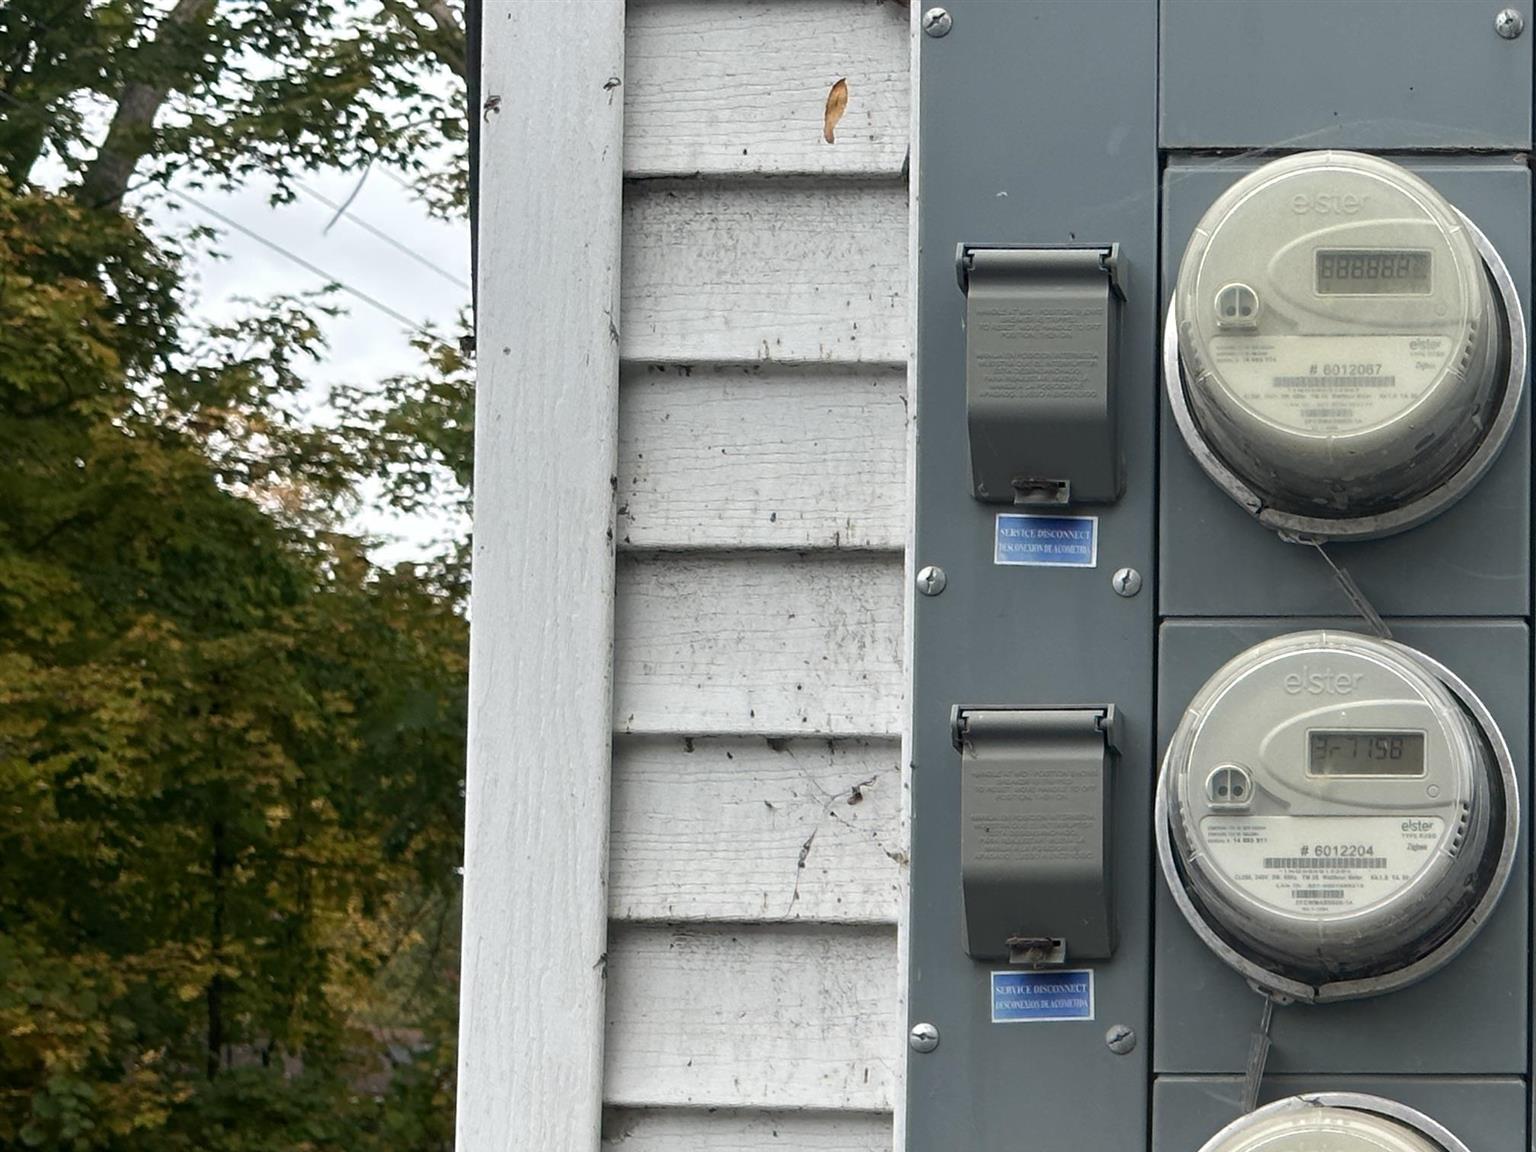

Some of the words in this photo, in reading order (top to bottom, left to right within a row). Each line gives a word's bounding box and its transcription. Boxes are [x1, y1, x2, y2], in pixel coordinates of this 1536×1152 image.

[1001, 528, 1036, 538] SERVICE
[1037, 529, 1090, 539] DISCONNECT
[1284, 664, 1364, 695] elster
[1401, 819, 1434, 832] elster
[1314, 845, 1374, 857] 6012204
[996, 985, 1032, 994] SERVICE
[1033, 984, 1087, 993] DISCONNECT
